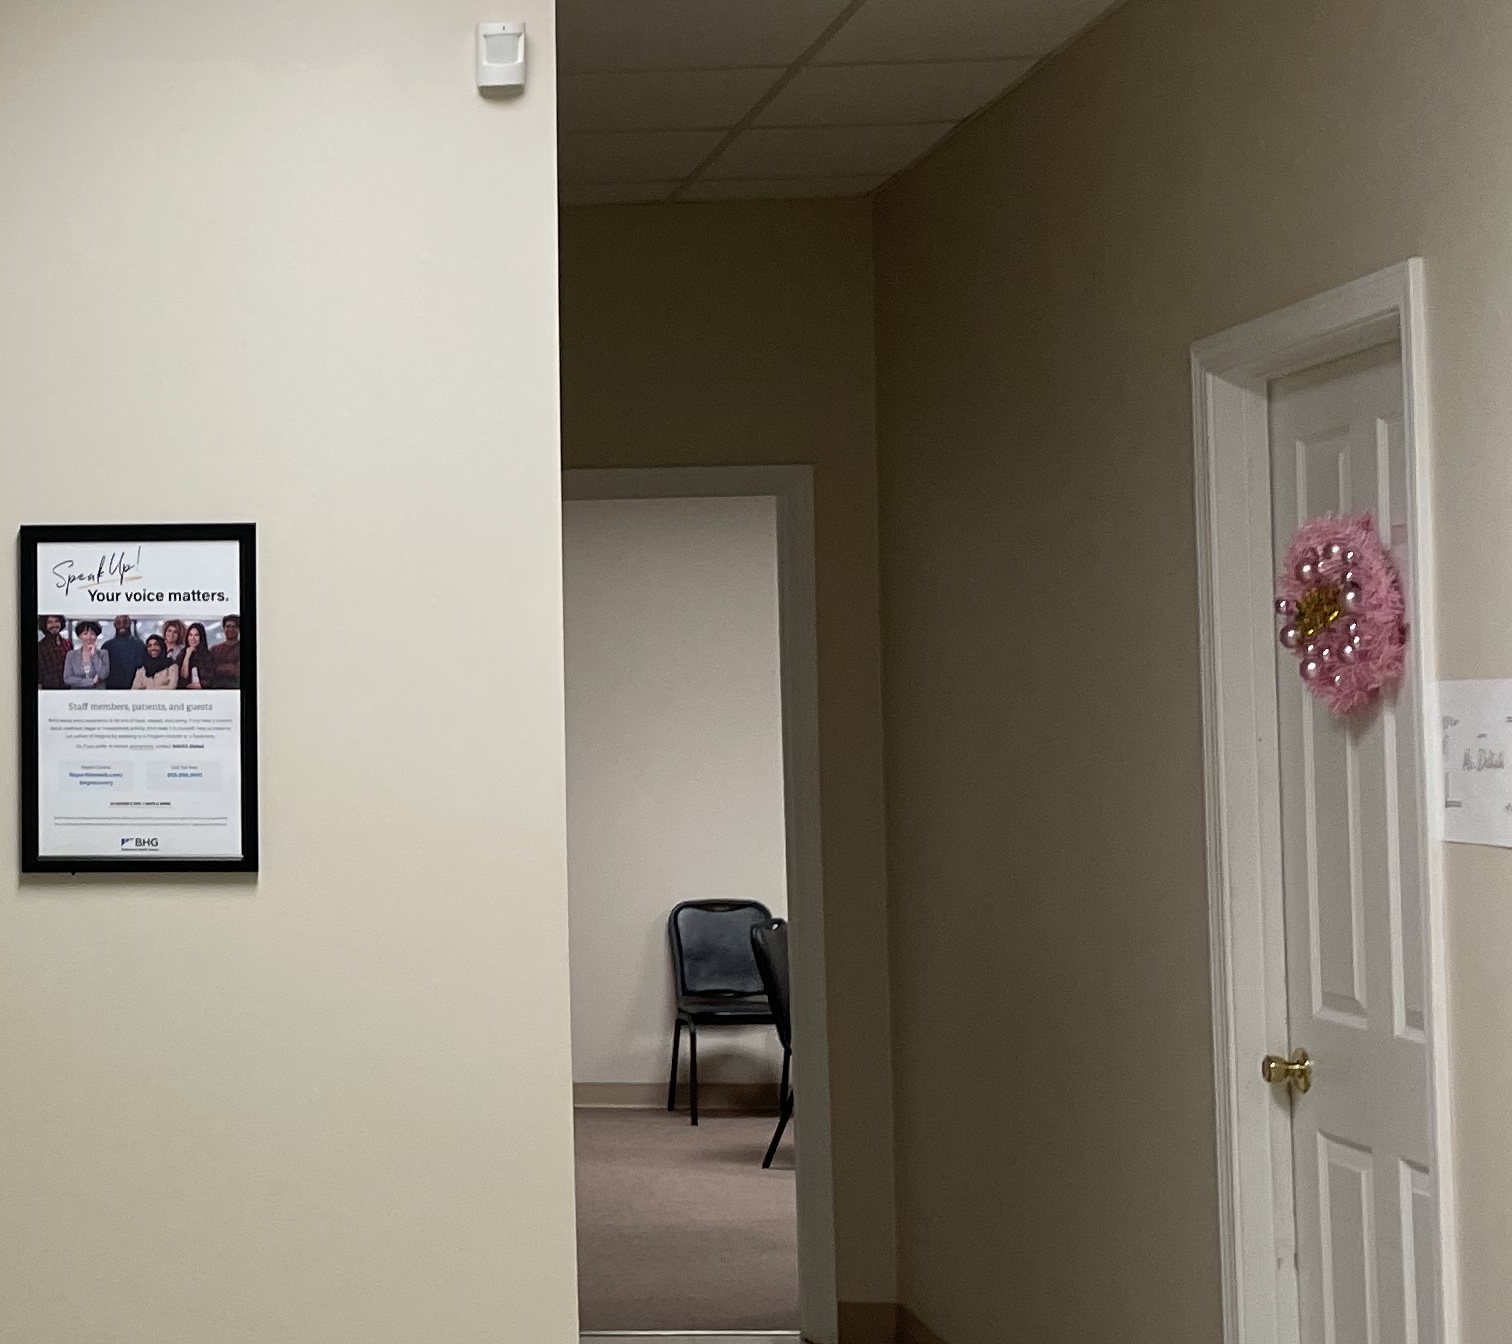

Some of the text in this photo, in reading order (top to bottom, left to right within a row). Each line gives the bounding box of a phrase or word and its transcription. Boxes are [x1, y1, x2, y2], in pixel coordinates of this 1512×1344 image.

[52, 545, 142, 596] Speak Up!
[88, 588, 230, 602] Your voice matters.
[68, 702, 89, 711] Staff
[169, 702, 184, 711] and
[186, 703, 213, 713] guests
[135, 838, 159, 847] BHG
